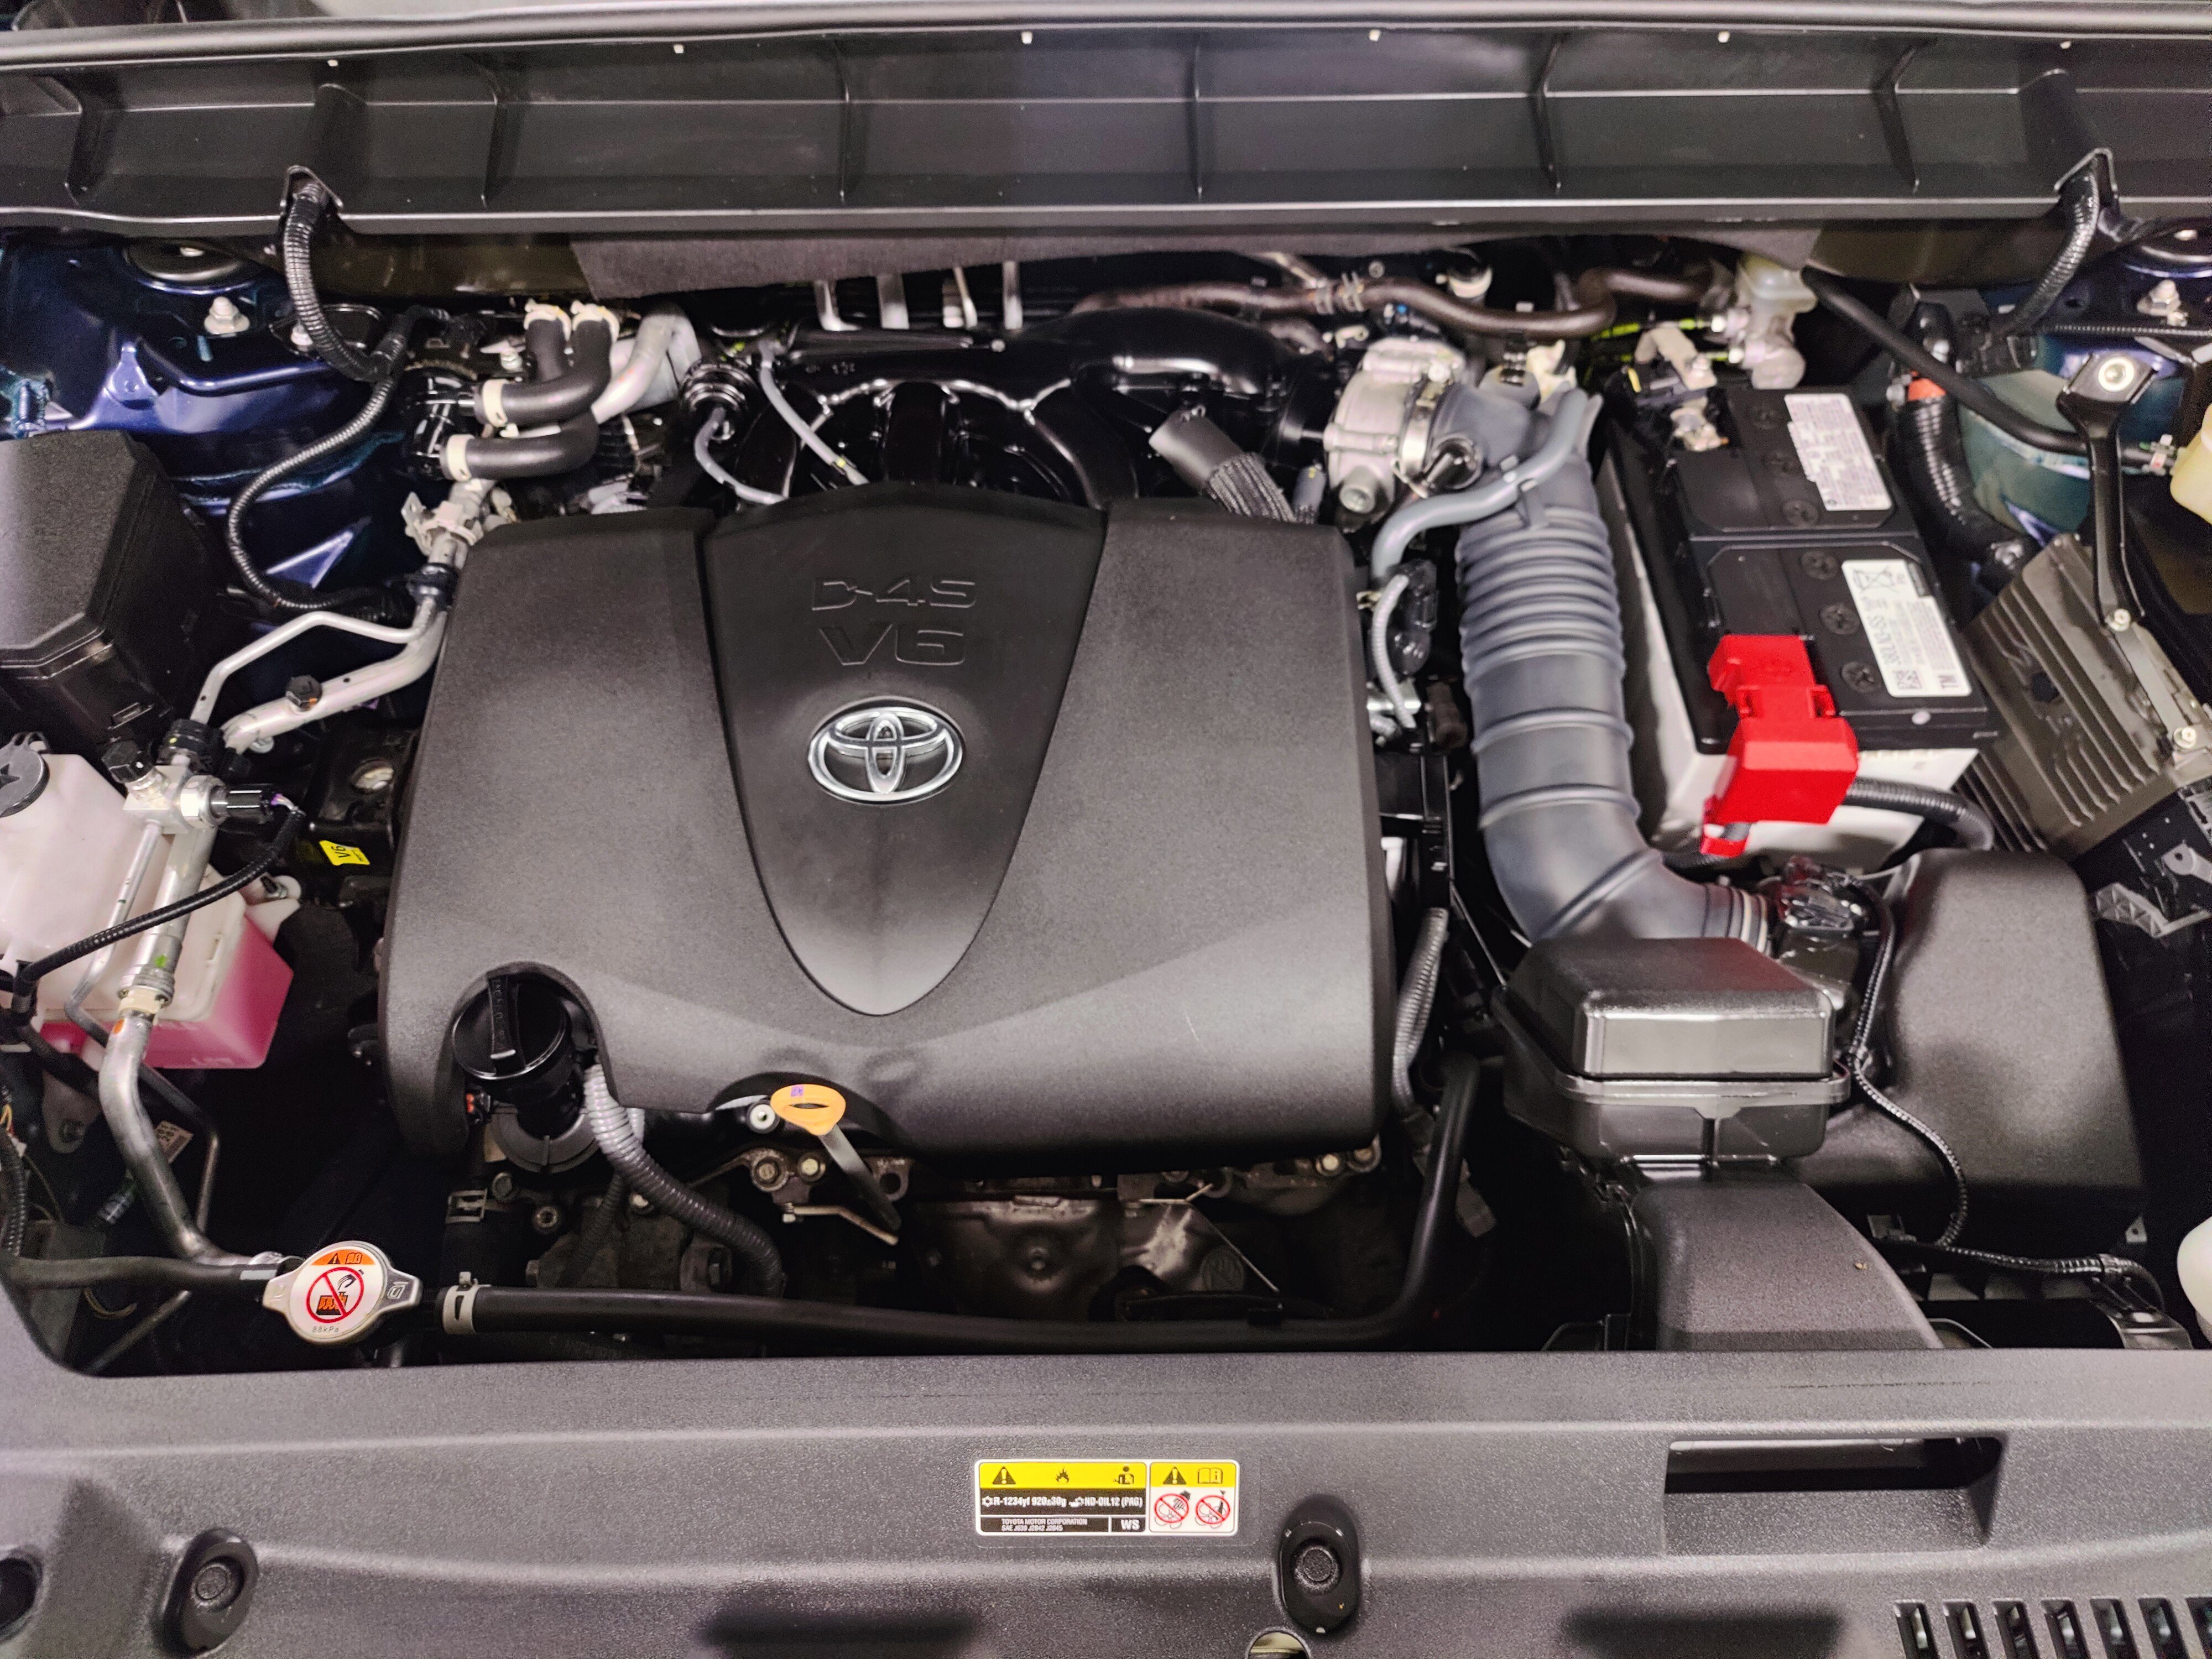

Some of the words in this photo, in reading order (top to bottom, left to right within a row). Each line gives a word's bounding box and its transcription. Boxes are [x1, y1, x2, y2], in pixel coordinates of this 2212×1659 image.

[812, 577, 976, 611] D-4S
[818, 622, 966, 666] V6
[331, 846, 351, 858] V6
[993, 1496, 1031, 1507] R-1234yf
[1031, 1496, 1067, 1508] 920±30g
[1084, 1496, 1120, 1506] ND-OIL12
[1121, 1496, 1144, 1508] (PAG)
[1120, 1519, 1140, 1531] WS
